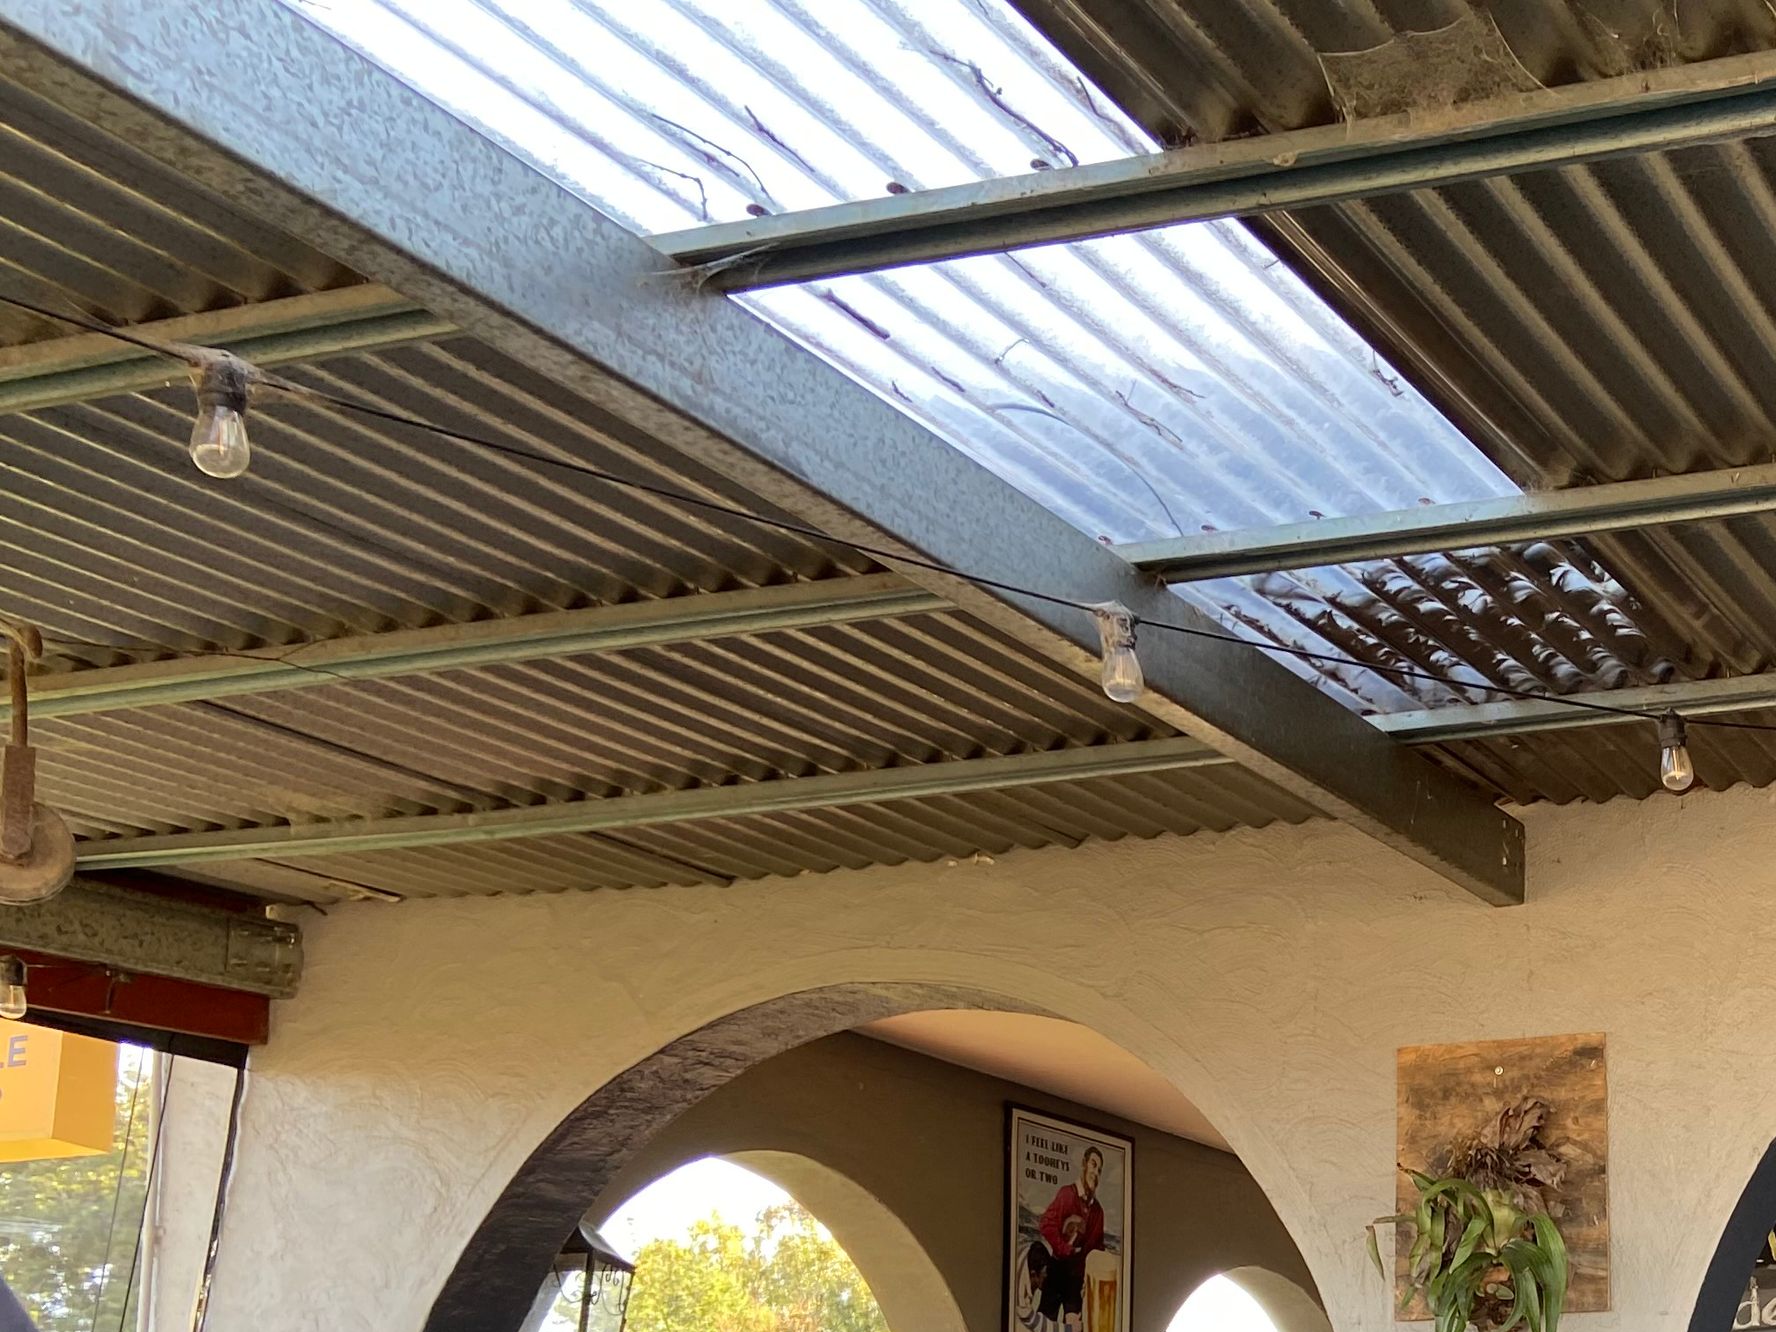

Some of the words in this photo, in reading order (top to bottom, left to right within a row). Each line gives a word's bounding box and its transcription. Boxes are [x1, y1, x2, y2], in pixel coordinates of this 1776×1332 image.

[1051, 1141, 1069, 1155] LIKE
[1025, 1151, 1031, 1161] A
[1033, 1153, 1070, 1172] TOOHEYS
[1025, 1168, 1037, 1180] OR
[1039, 1171, 1058, 1185] TWO
